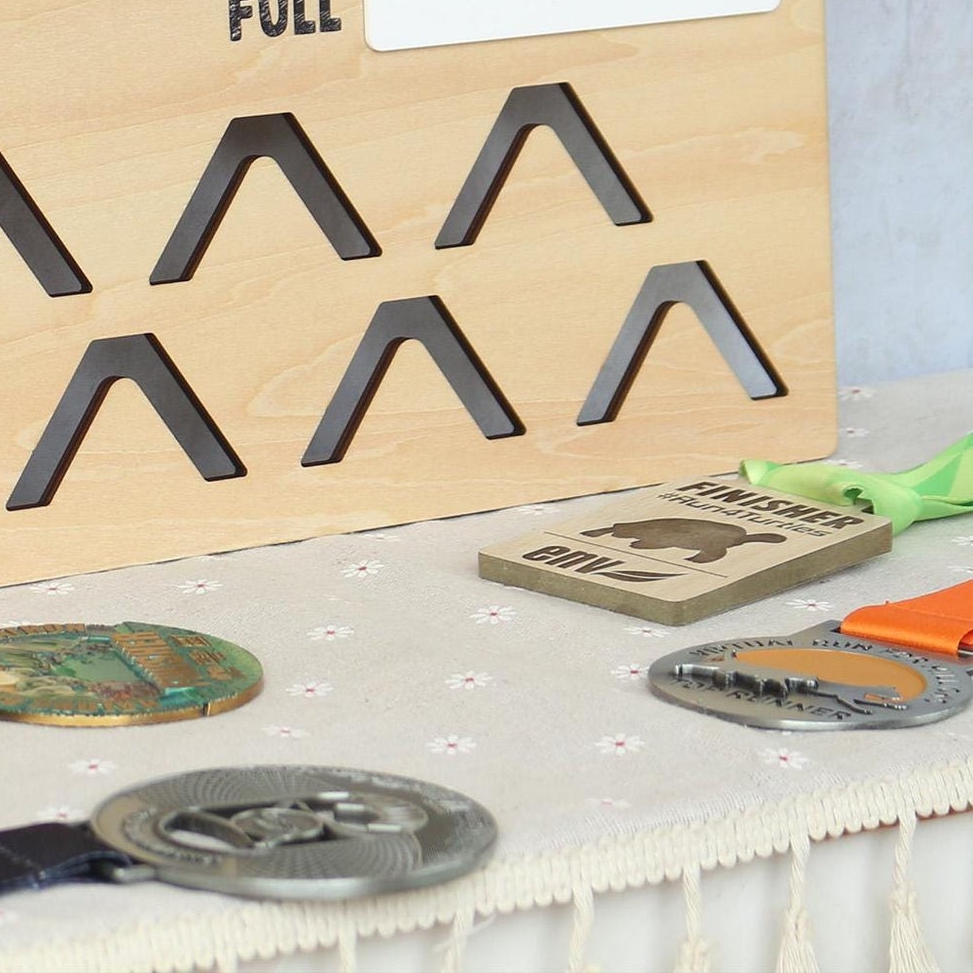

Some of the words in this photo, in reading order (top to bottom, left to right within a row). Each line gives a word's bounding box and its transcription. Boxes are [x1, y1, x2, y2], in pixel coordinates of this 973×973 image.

[678, 481, 865, 530] FINISHER
[522, 545, 626, 575] env
[812, 638, 872, 653] RUN
[726, 688, 852, 720] RUNNER
